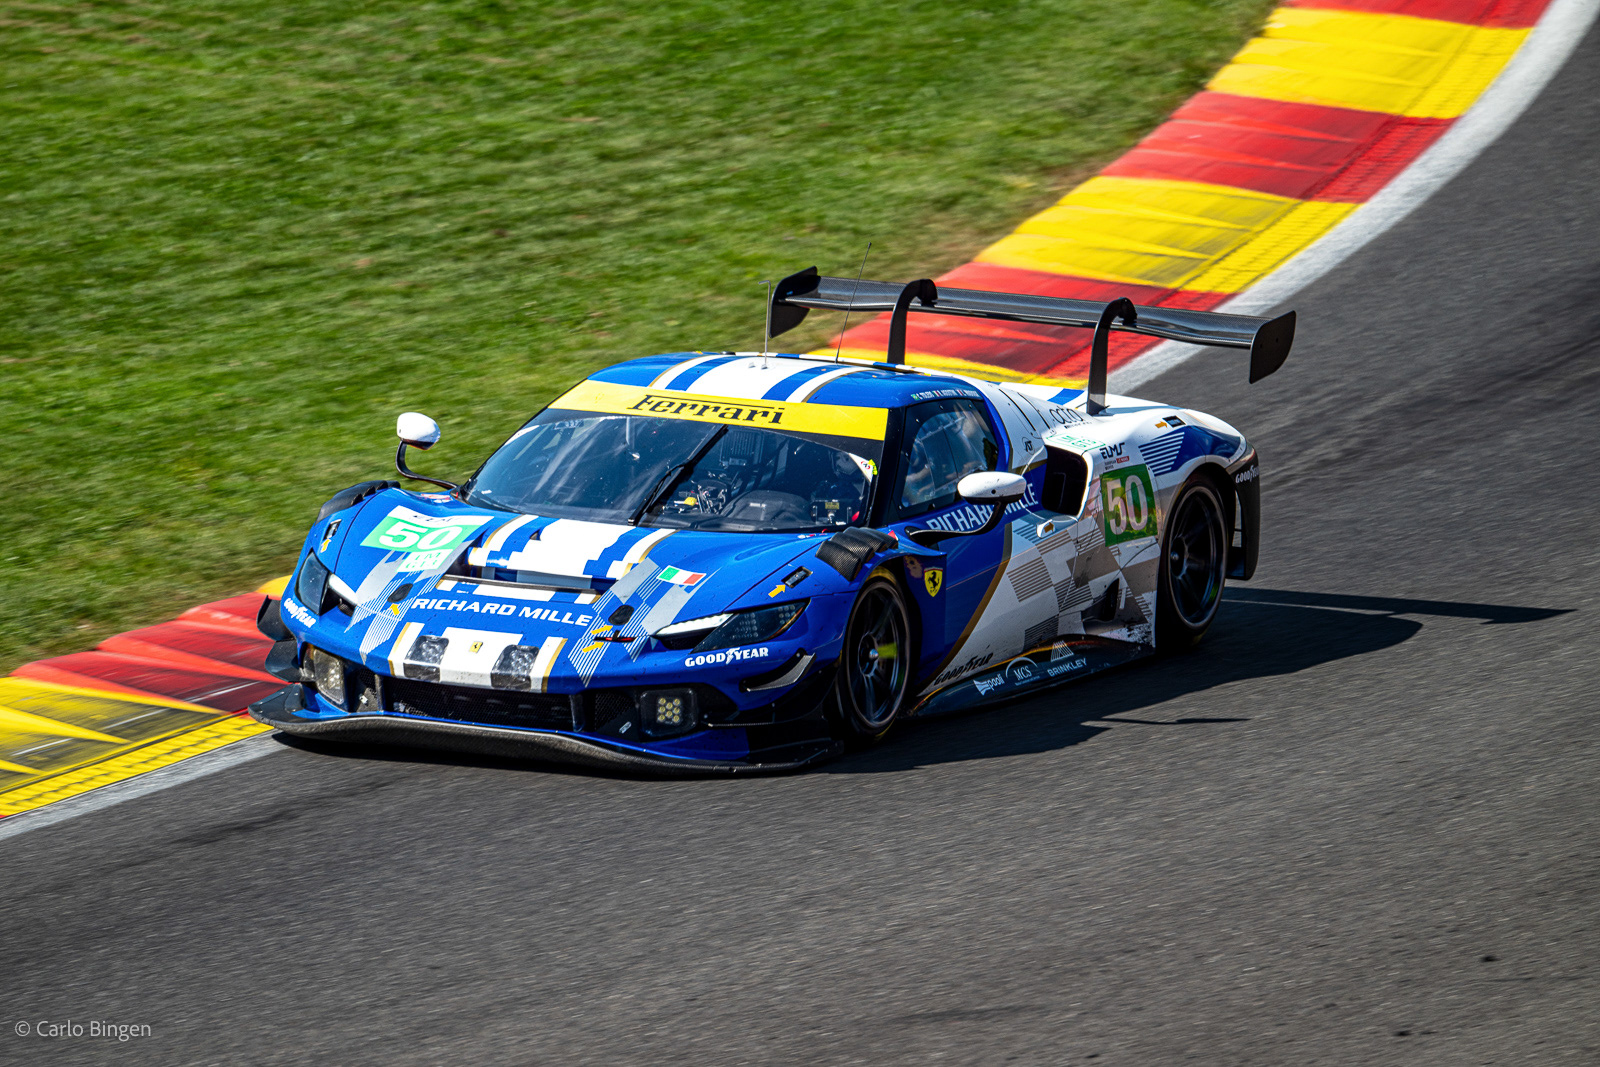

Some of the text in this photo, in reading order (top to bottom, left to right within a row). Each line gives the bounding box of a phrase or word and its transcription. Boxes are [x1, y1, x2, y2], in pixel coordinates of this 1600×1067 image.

[627, 394, 785, 424] Ferrari
[1106, 475, 1148, 535] 50
[379, 521, 463, 550] 50
[411, 598, 593, 627] RICHARD MILLE
[684, 646, 769, 667] GOODYEAR
[934, 652, 993, 686] GOODYEAR
[1047, 657, 1088, 677] BRINKLEY
[1013, 665, 1033, 681] MCS
